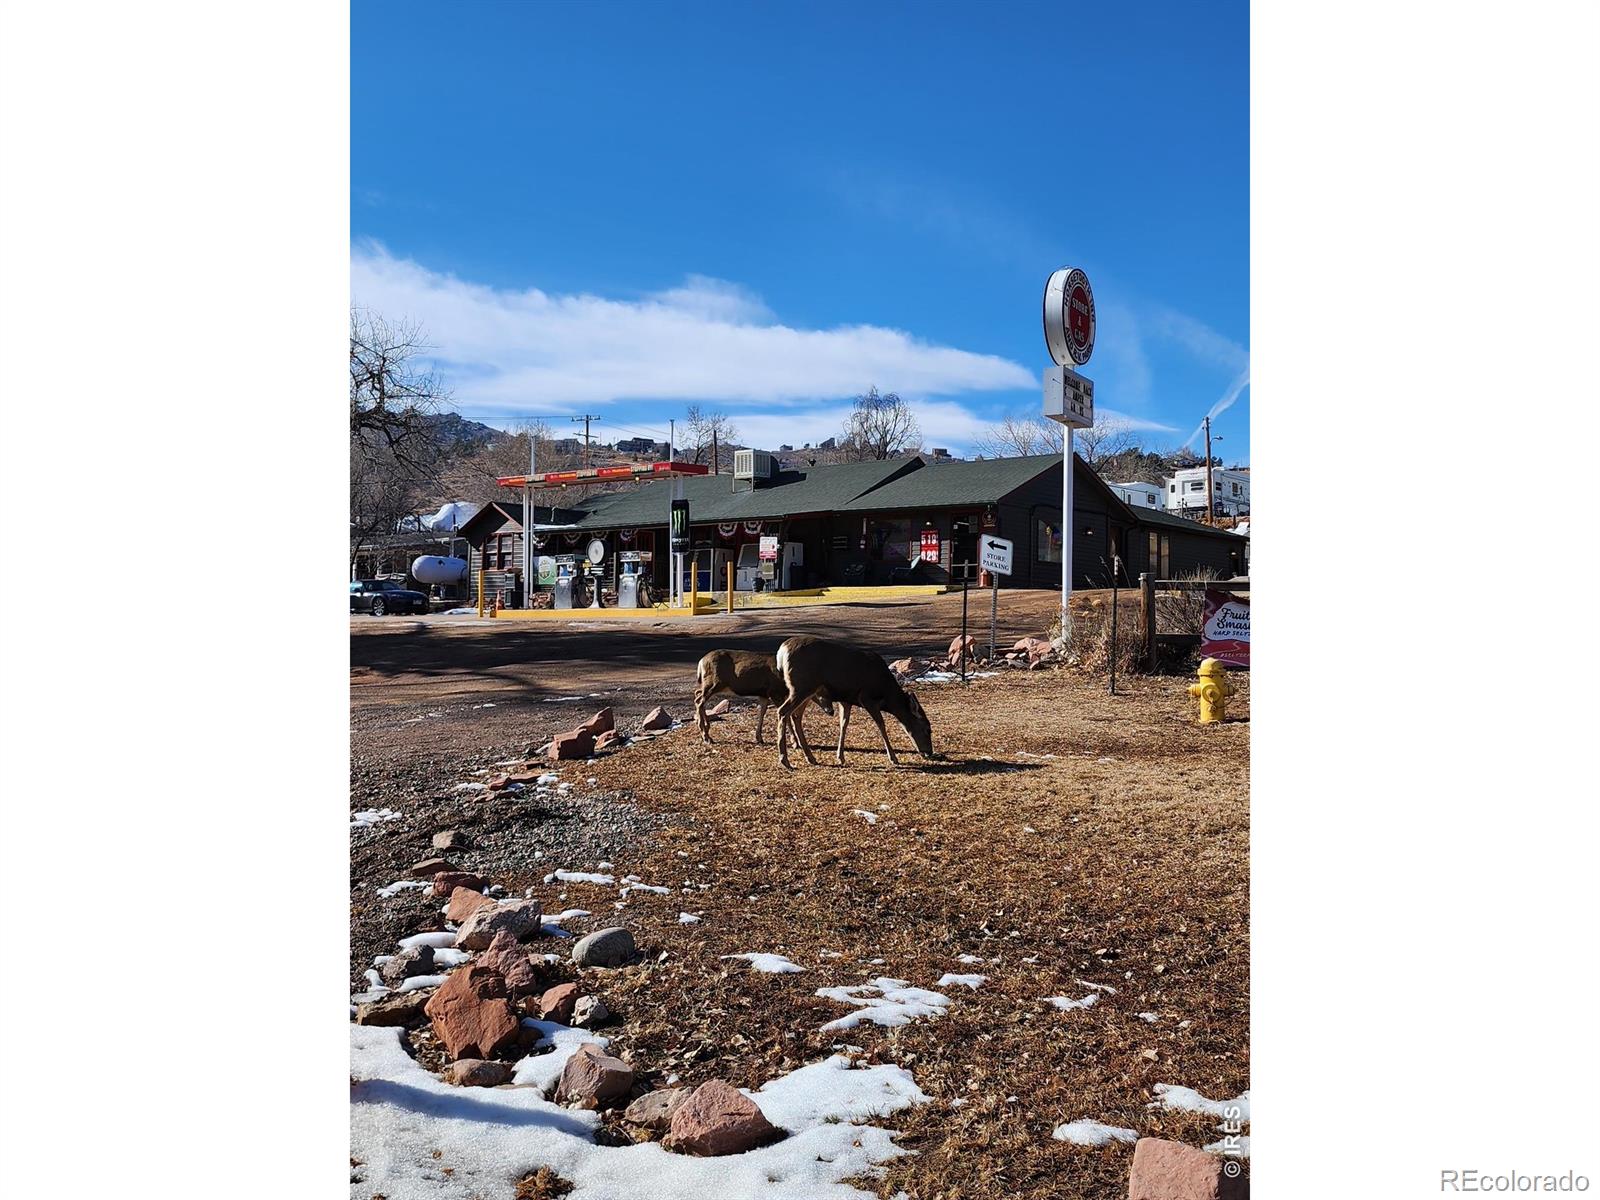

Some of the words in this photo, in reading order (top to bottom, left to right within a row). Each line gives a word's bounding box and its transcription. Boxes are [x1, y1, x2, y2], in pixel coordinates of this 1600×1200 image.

[1071, 298, 1089, 316] STORE
[1074, 329, 1085, 343] GAS
[986, 552, 1006, 562] STORE
[982, 560, 1009, 571] PARKING
[1221, 607, 1250, 620] Fruit
